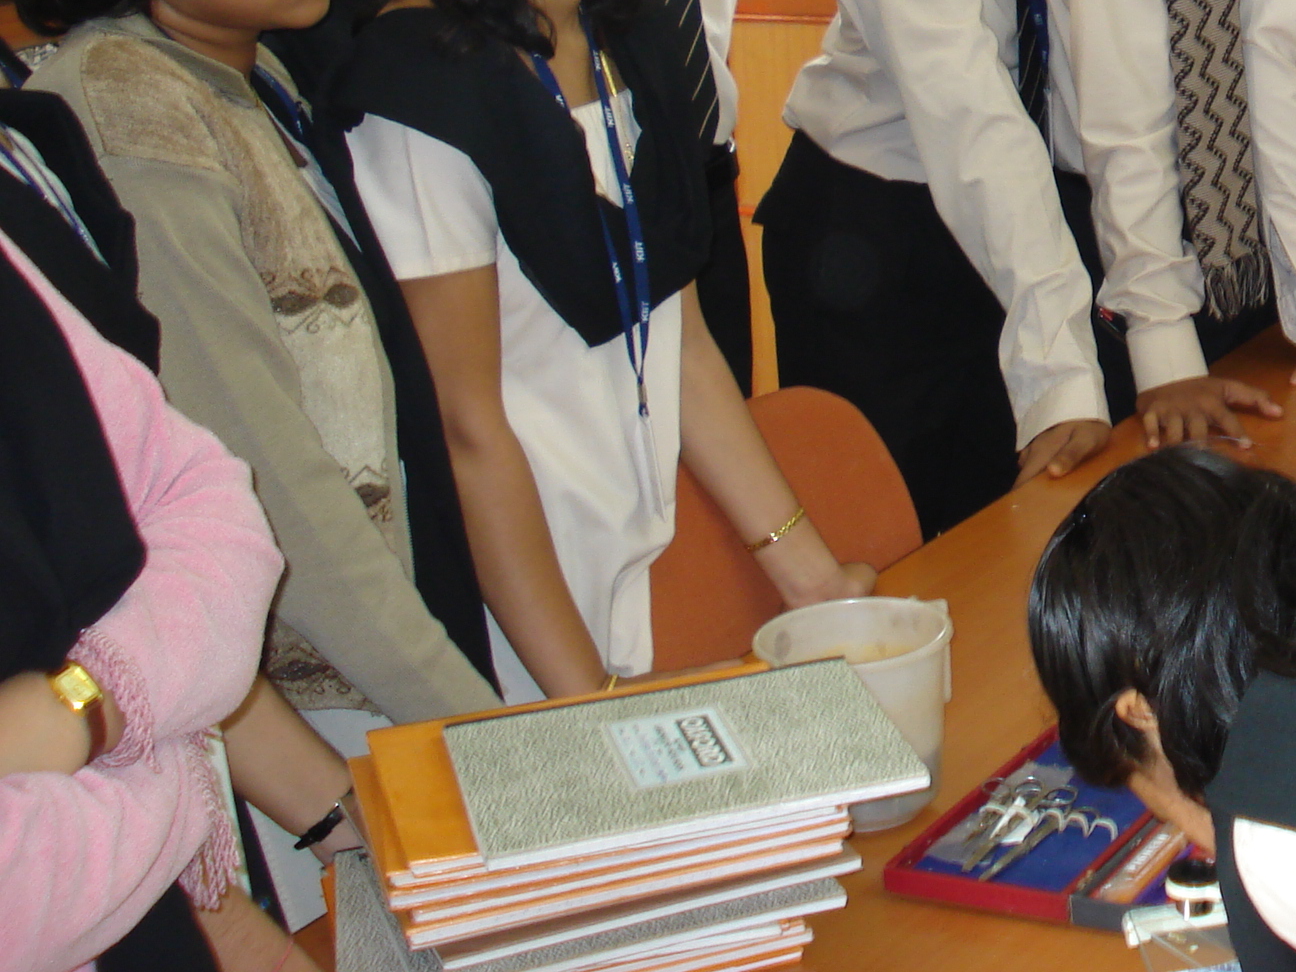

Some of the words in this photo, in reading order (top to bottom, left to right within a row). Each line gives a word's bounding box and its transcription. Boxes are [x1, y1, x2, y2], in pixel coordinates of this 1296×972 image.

[604, 105, 616, 127] KIIT
[622, 183, 635, 204] KIIT
[635, 240, 646, 263] KIIT
[641, 301, 651, 323] KIIT
